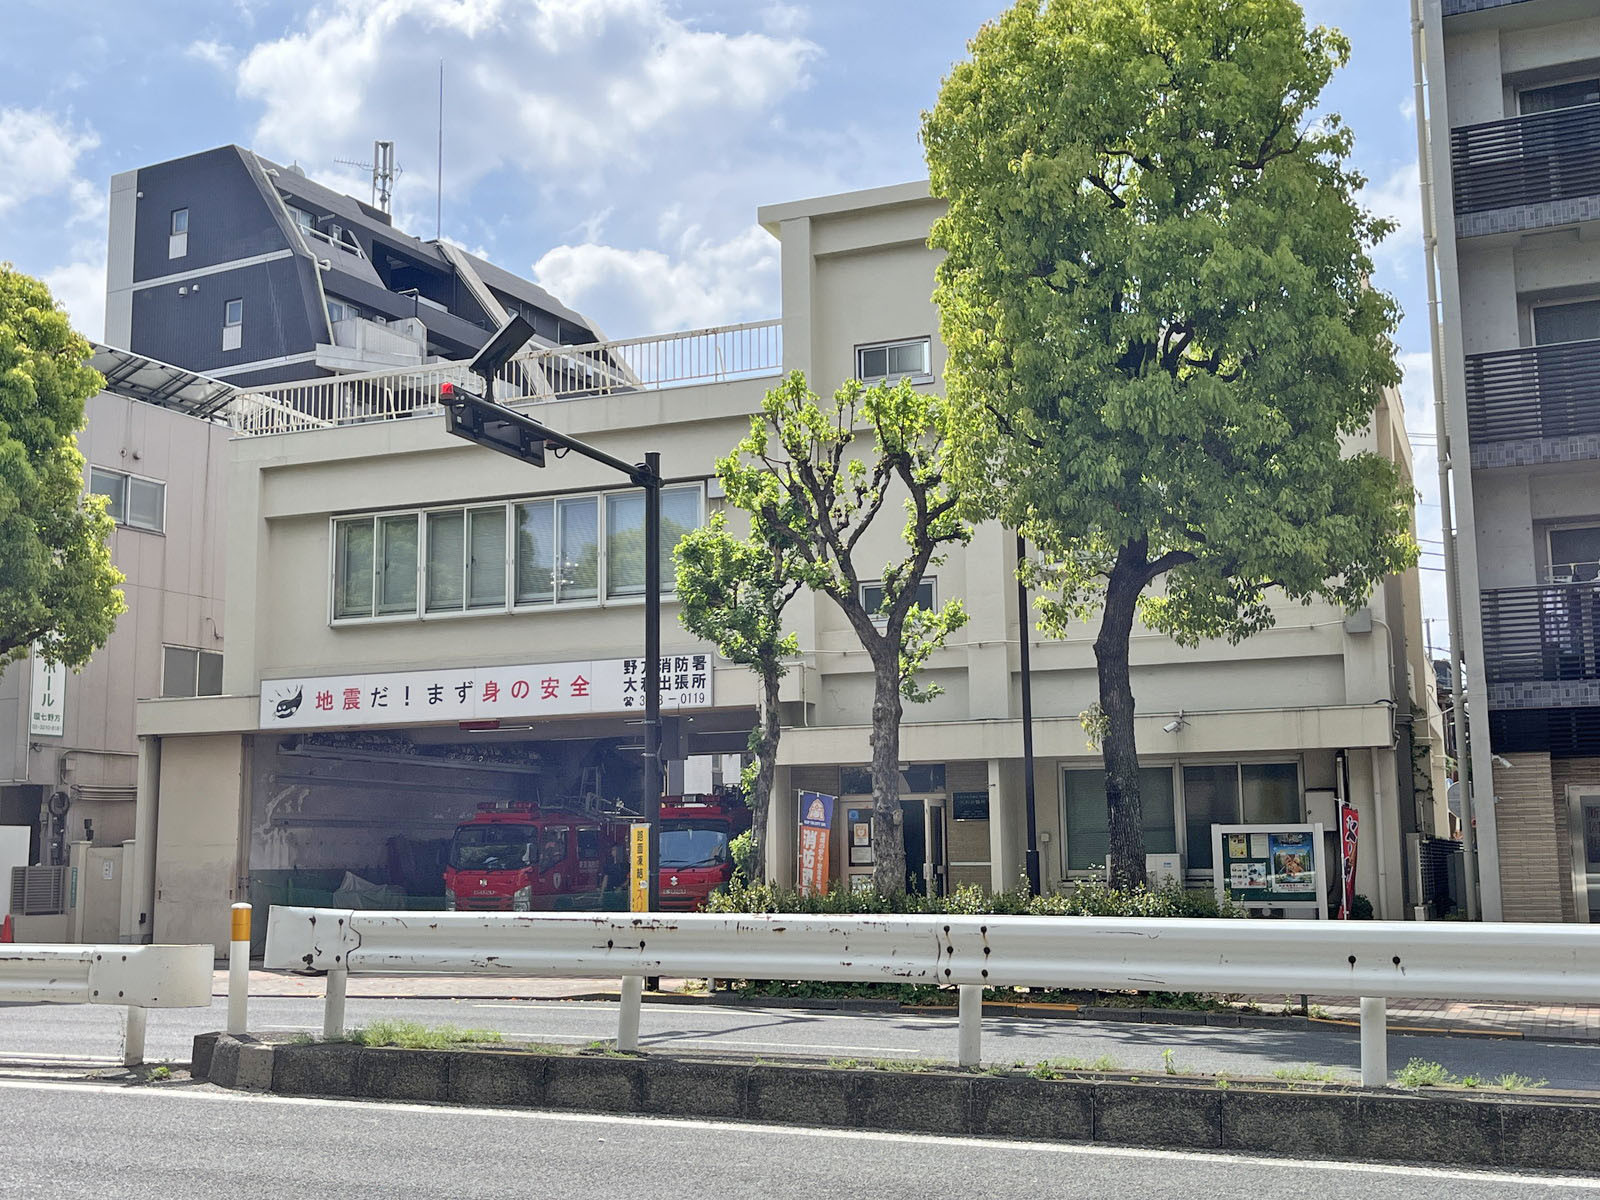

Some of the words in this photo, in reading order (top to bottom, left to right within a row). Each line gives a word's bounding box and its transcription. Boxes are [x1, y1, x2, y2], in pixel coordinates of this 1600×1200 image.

[314, 674, 592, 712] 地震だ！まず身の安全
[639, 692, 705, 707] 38-0119
